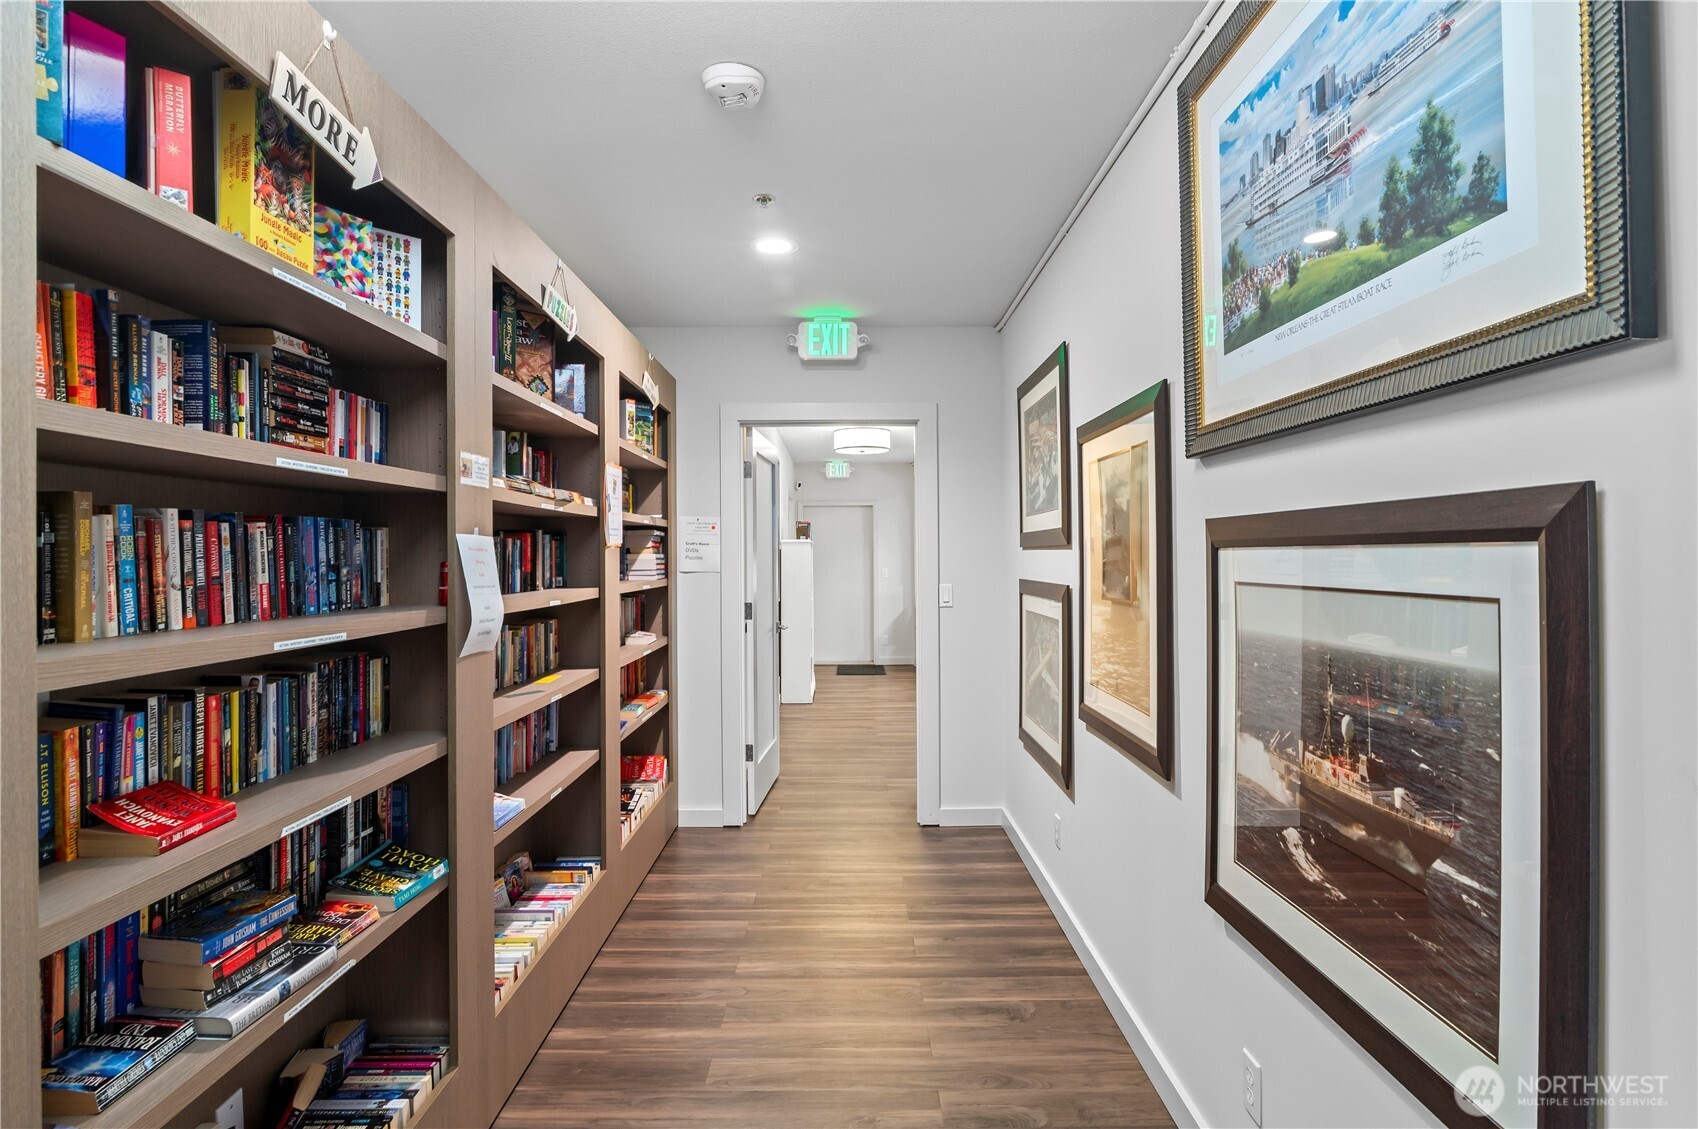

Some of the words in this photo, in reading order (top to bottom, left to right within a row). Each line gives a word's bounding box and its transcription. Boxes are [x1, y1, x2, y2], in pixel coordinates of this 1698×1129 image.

[165, 83, 174, 133] MIGRATION
[175, 85, 185, 134] BUTTERFLY
[282, 69, 359, 166] MORE
[242, 135, 250, 159] Jungle
[241, 159, 249, 183] Magic
[261, 213, 282, 231] Jungle
[283, 224, 303, 243] Magic
[255, 236, 269, 250] 100
[293, 256, 309, 271] Puzzle
[1274, 330, 1286, 343] NEW
[1320, 304, 1338, 320] GREAT
[1337, 286, 1375, 313] STEAMBOAT
[1375, 277, 1393, 294] RACE
[808, 323, 850, 356] EXIT
[210, 357, 218, 390] BROWN
[829, 463, 848, 477] EXIT
[126, 535, 134, 561] ROBIN
[154, 534, 162, 557] STEPHEN
[195, 533, 203, 558] PATRICIA
[196, 558, 205, 587] CORNWELL
[123, 587, 136, 624] CRITICAL
[196, 693, 204, 726] JOSEPH
[40, 744, 48, 762] J.T.
[136, 740, 144, 760] JANET
[196, 726, 204, 756] FINDER
[68, 757, 76, 781] JANET
[646, 756, 654, 775] Walk
[41, 763, 49, 807] ELLISON
[69, 781, 78, 824] EVANOVICH
[114, 798, 184, 827] EVANOVICH
[114, 811, 158, 829] JANET
[381, 852, 430, 872] TAMI
[388, 845, 441, 866] HOAG
[360, 869, 410, 885] GRAVE
[398, 892, 410, 903] TAMI
[222, 935, 235, 950] JOHN
[234, 922, 257, 942] GRISHAM
[260, 918, 268, 929] THE
[268, 901, 294, 922] CONFESSION
[268, 952, 291, 968] GRISHAM
[271, 947, 285, 960] JOHN
[306, 960, 330, 978] GRISHAM
[234, 1018, 248, 1032] THE
[248, 995, 278, 1022] BRETHREN
[79, 1032, 164, 1051] RAINBOW'S
[120, 1023, 157, 1036] END
